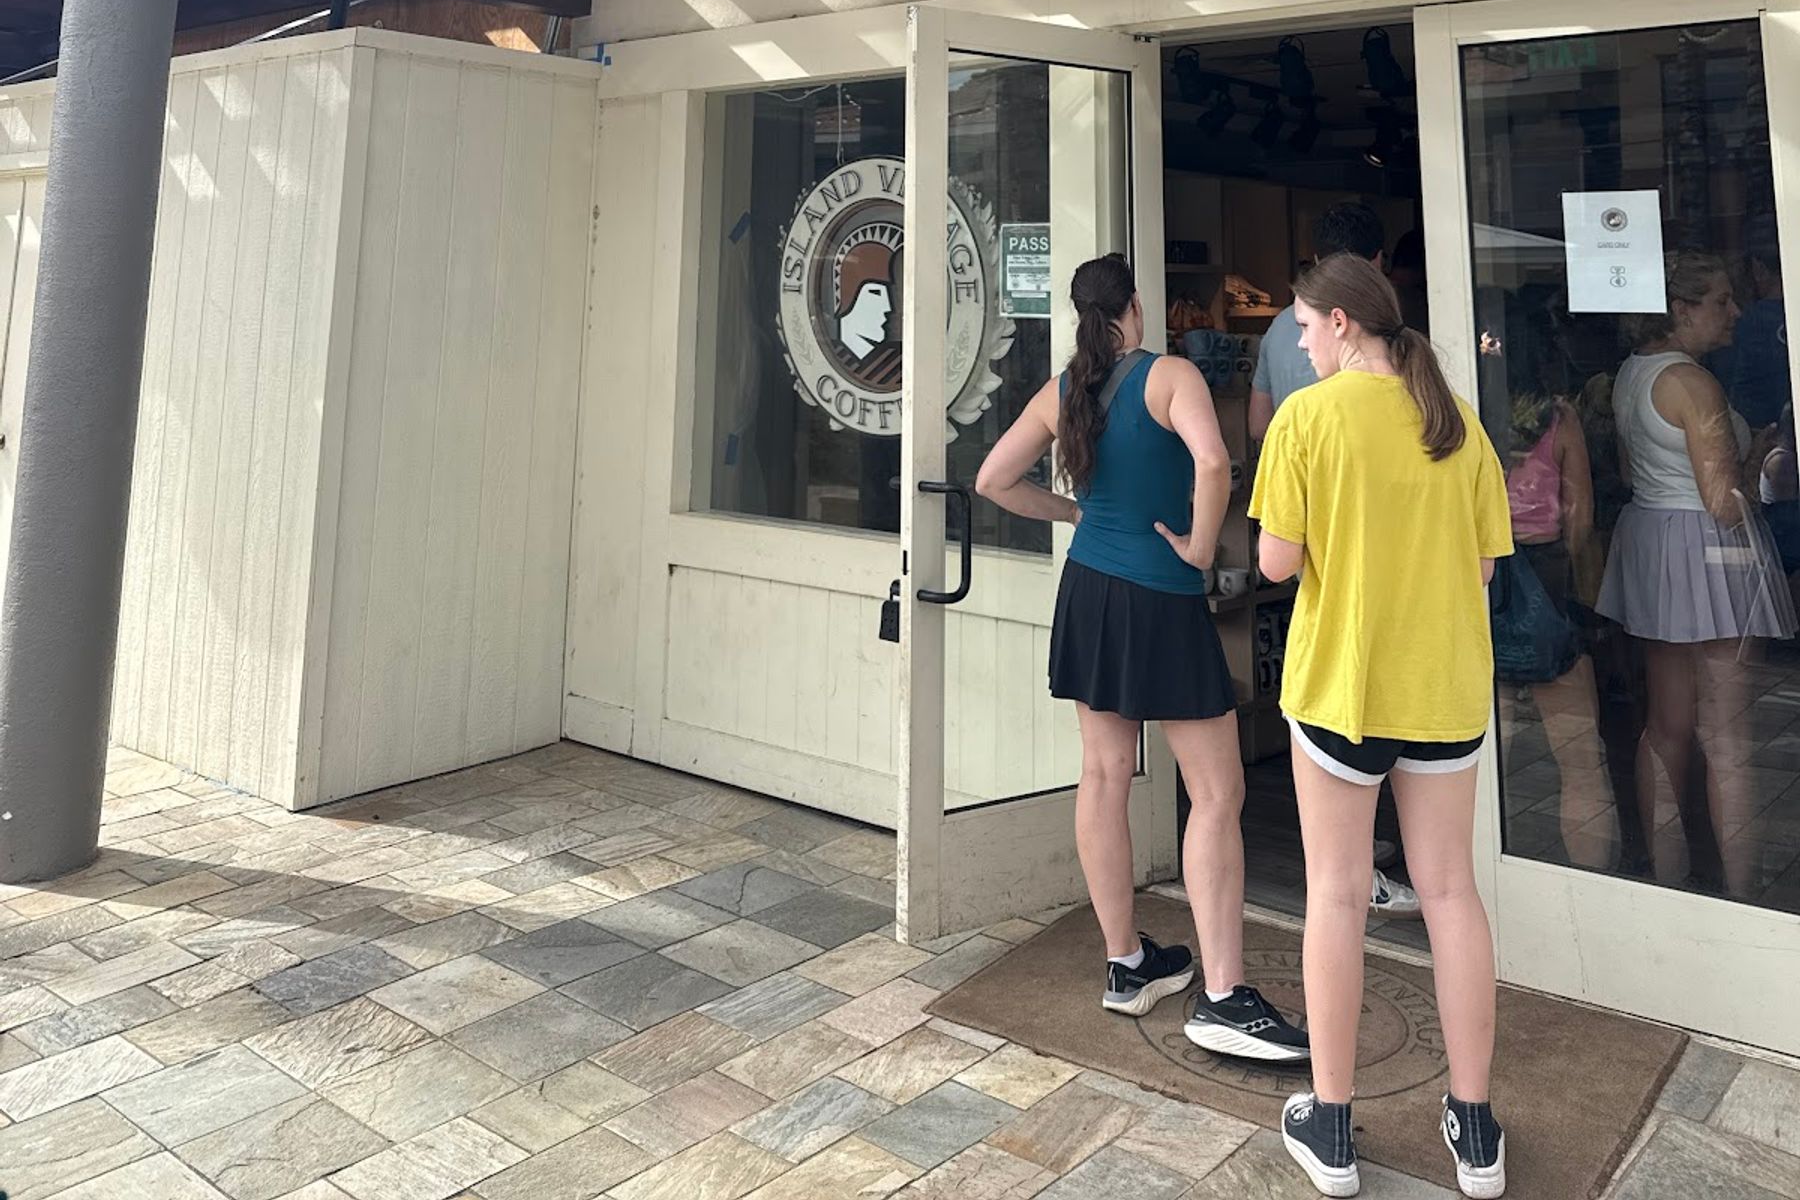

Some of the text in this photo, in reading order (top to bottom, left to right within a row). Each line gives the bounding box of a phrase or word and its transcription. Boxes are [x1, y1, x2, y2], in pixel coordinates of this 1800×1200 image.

[783, 164, 980, 304] ISLAND VIAGE
[1009, 237, 1049, 251] PASS
[816, 373, 902, 429] COFF
[1162, 1031, 1308, 1093] COFFE
